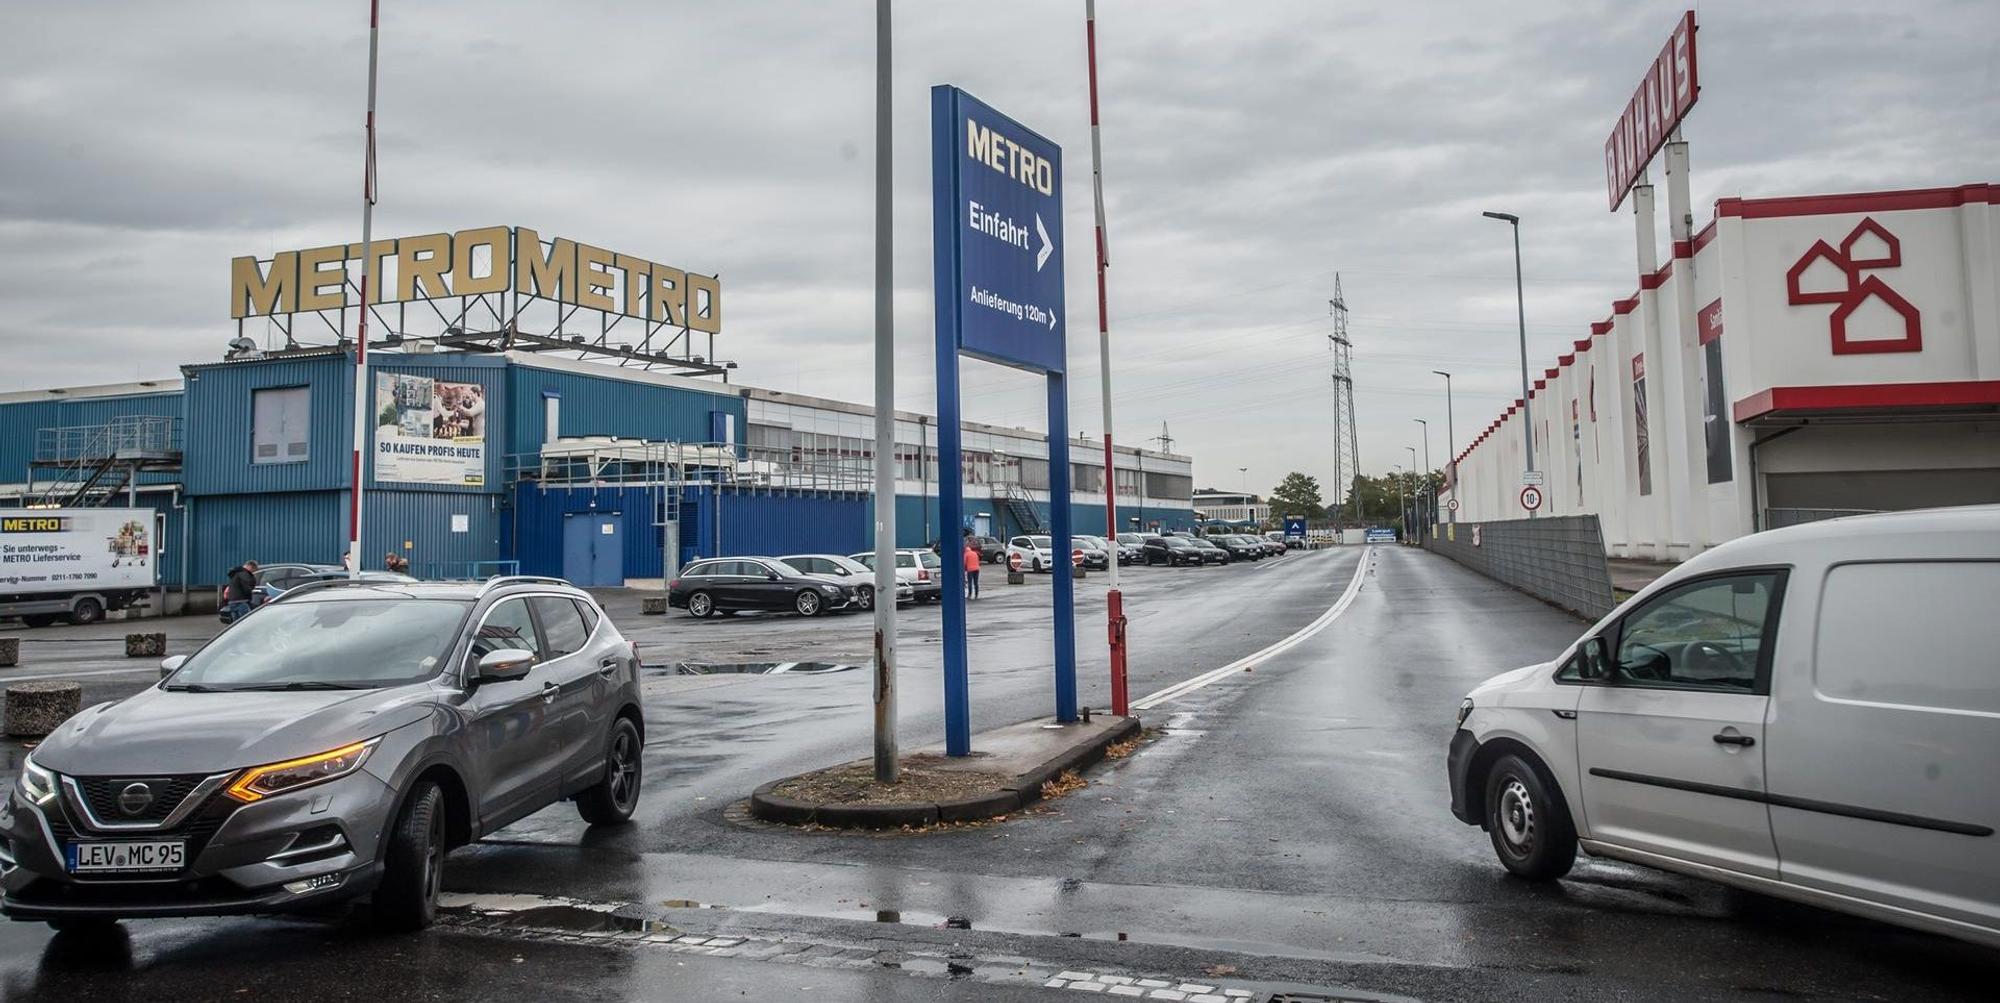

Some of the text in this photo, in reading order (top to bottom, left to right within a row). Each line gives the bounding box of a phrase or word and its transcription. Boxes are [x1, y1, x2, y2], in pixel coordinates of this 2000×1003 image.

[1607, 30, 1690, 195] BAUHAUS
[967, 117, 1053, 197] METRO
[969, 200, 1029, 250] Einfahrt
[231, 225, 511, 319] METRO
[514, 226, 720, 334] METRO
[970, 286, 1047, 325] Anlieferung 120m
[380, 442, 480, 459] SO KAUFEN PROFIS HEUTE
[3, 519, 59, 531] METRO
[3, 545, 15, 553] Sie
[18, 544, 58, 553] unterwegs
[3, 552, 81, 563] METRO Lieferservice
[79, 844, 183, 865] LEV MC 95
